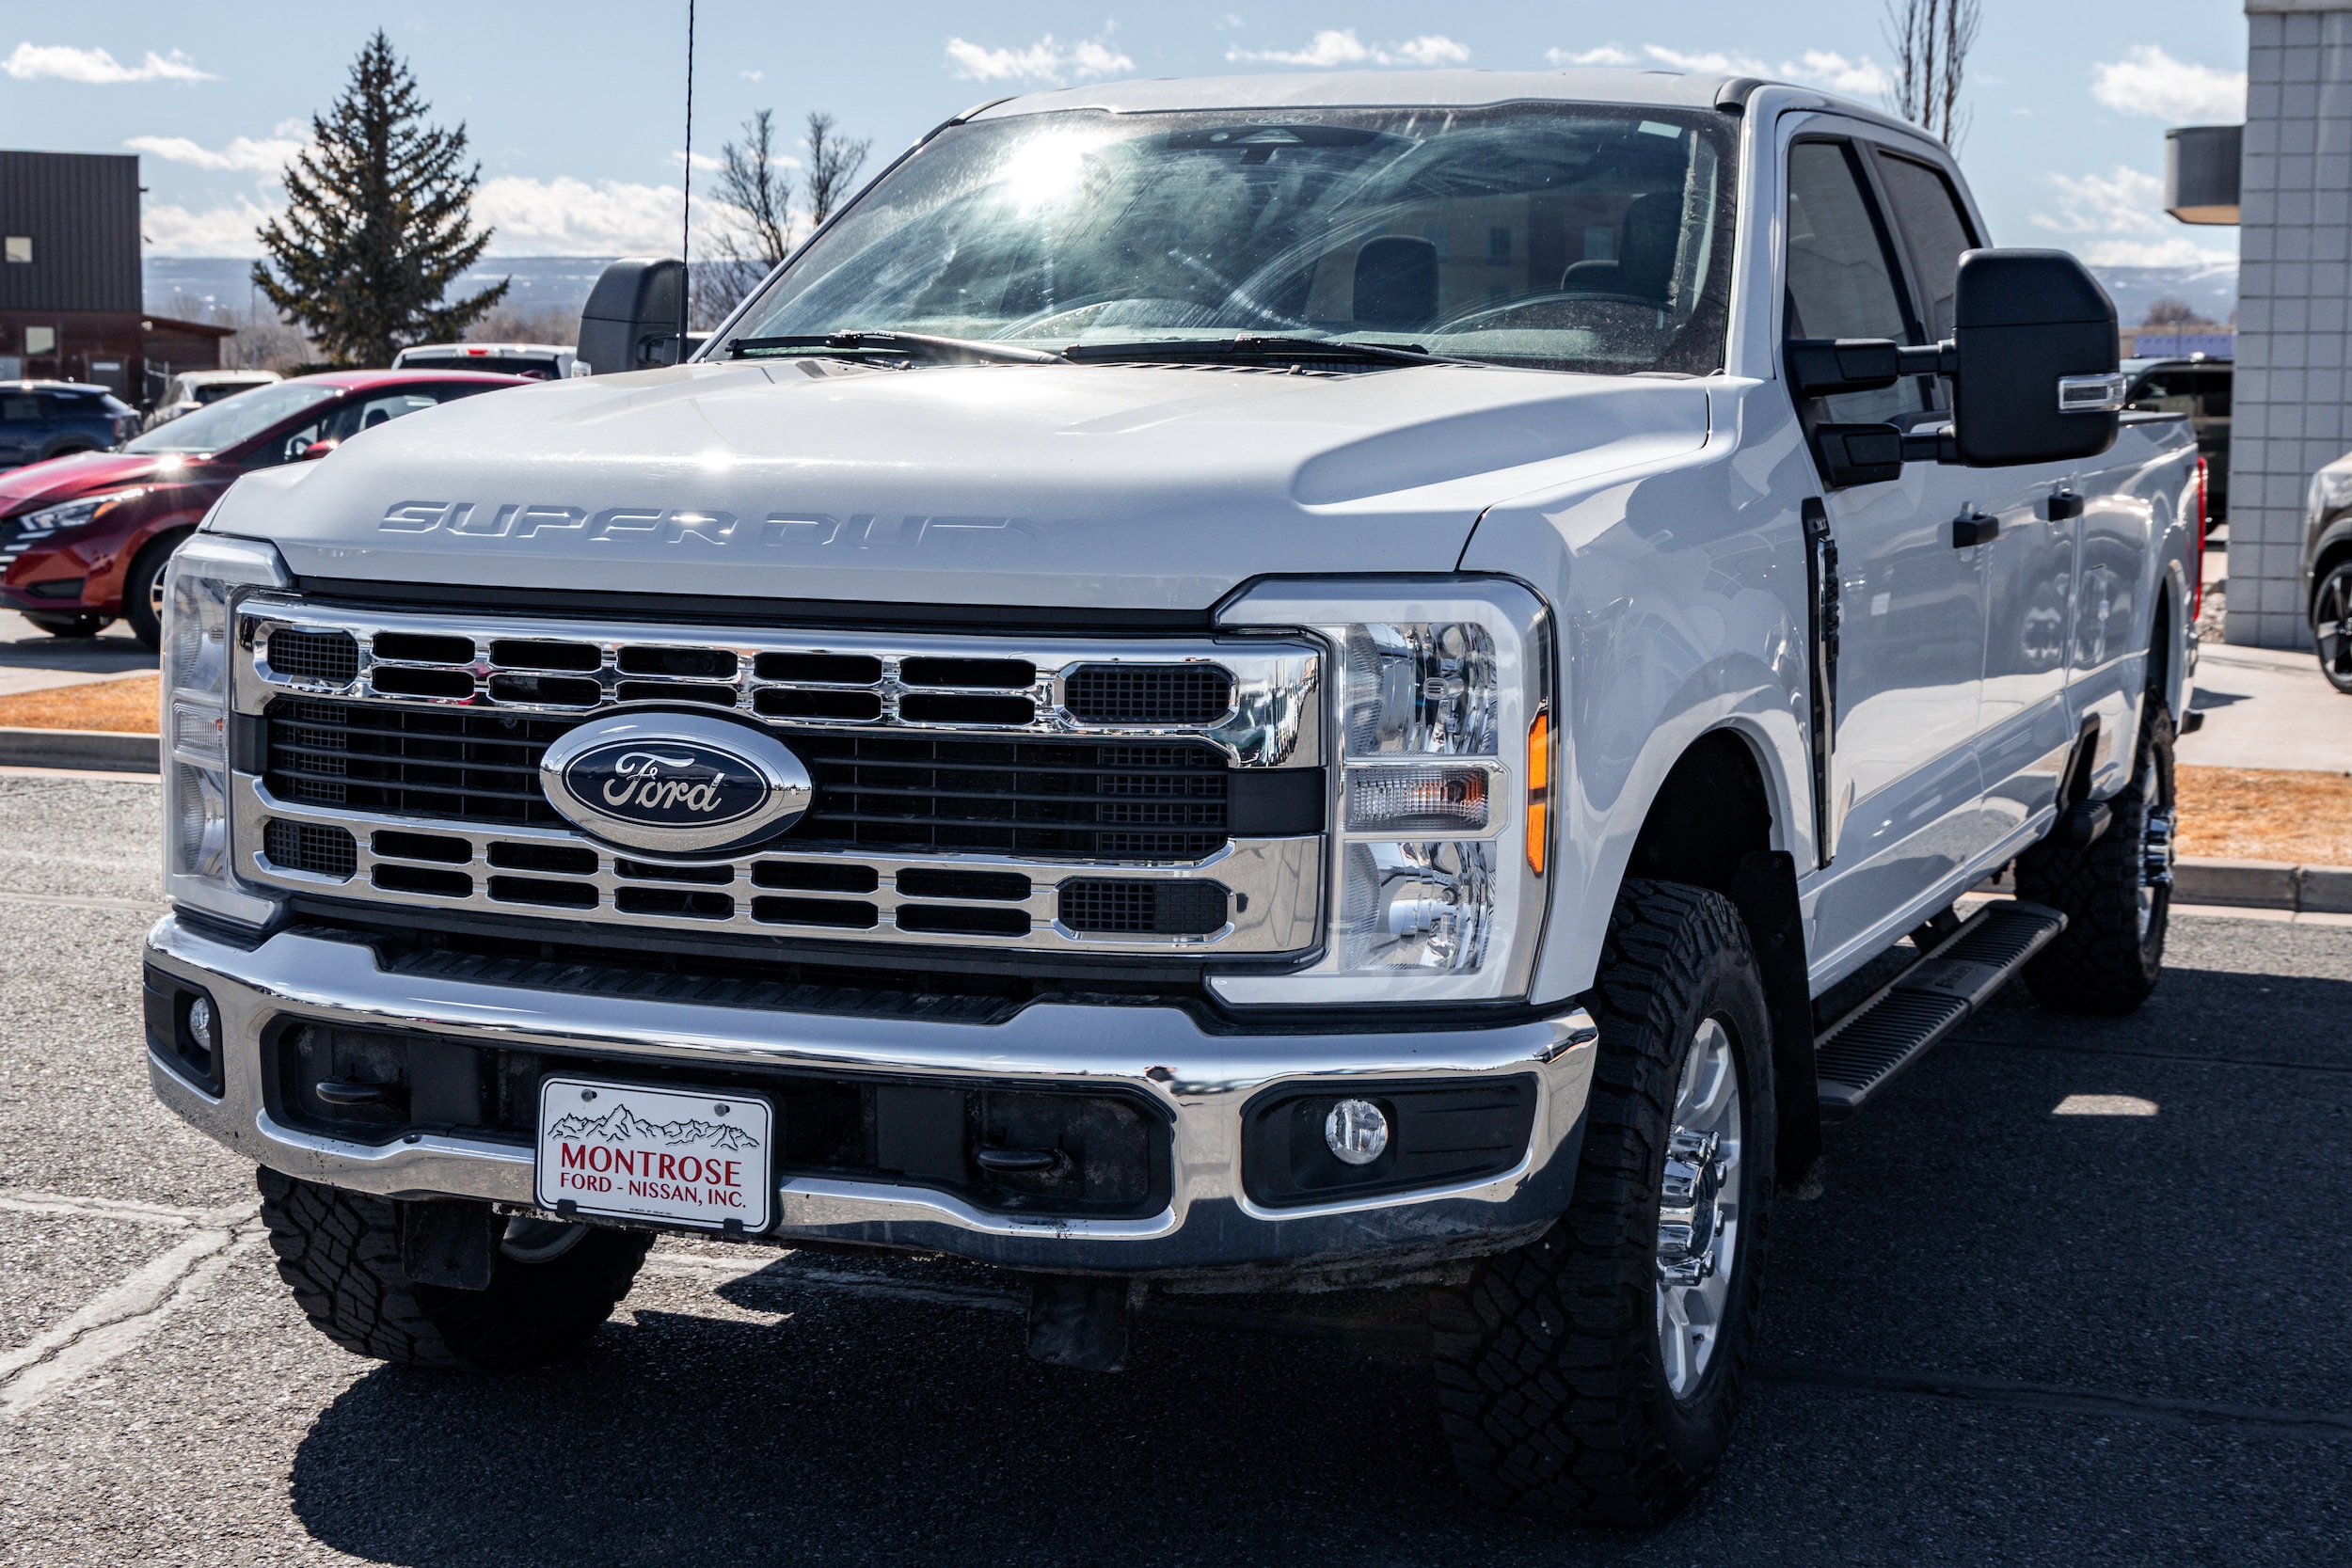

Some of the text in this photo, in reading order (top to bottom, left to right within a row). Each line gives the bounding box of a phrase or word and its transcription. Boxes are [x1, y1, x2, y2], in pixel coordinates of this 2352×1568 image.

[378, 500, 1039, 549] SUPER DUT
[602, 752, 726, 813] Ford
[560, 1142, 742, 1188] MONTROSE
[560, 1172, 612, 1193] FORD
[628, 1180, 703, 1207] NISSAN,
[707, 1189, 747, 1210] INC.
